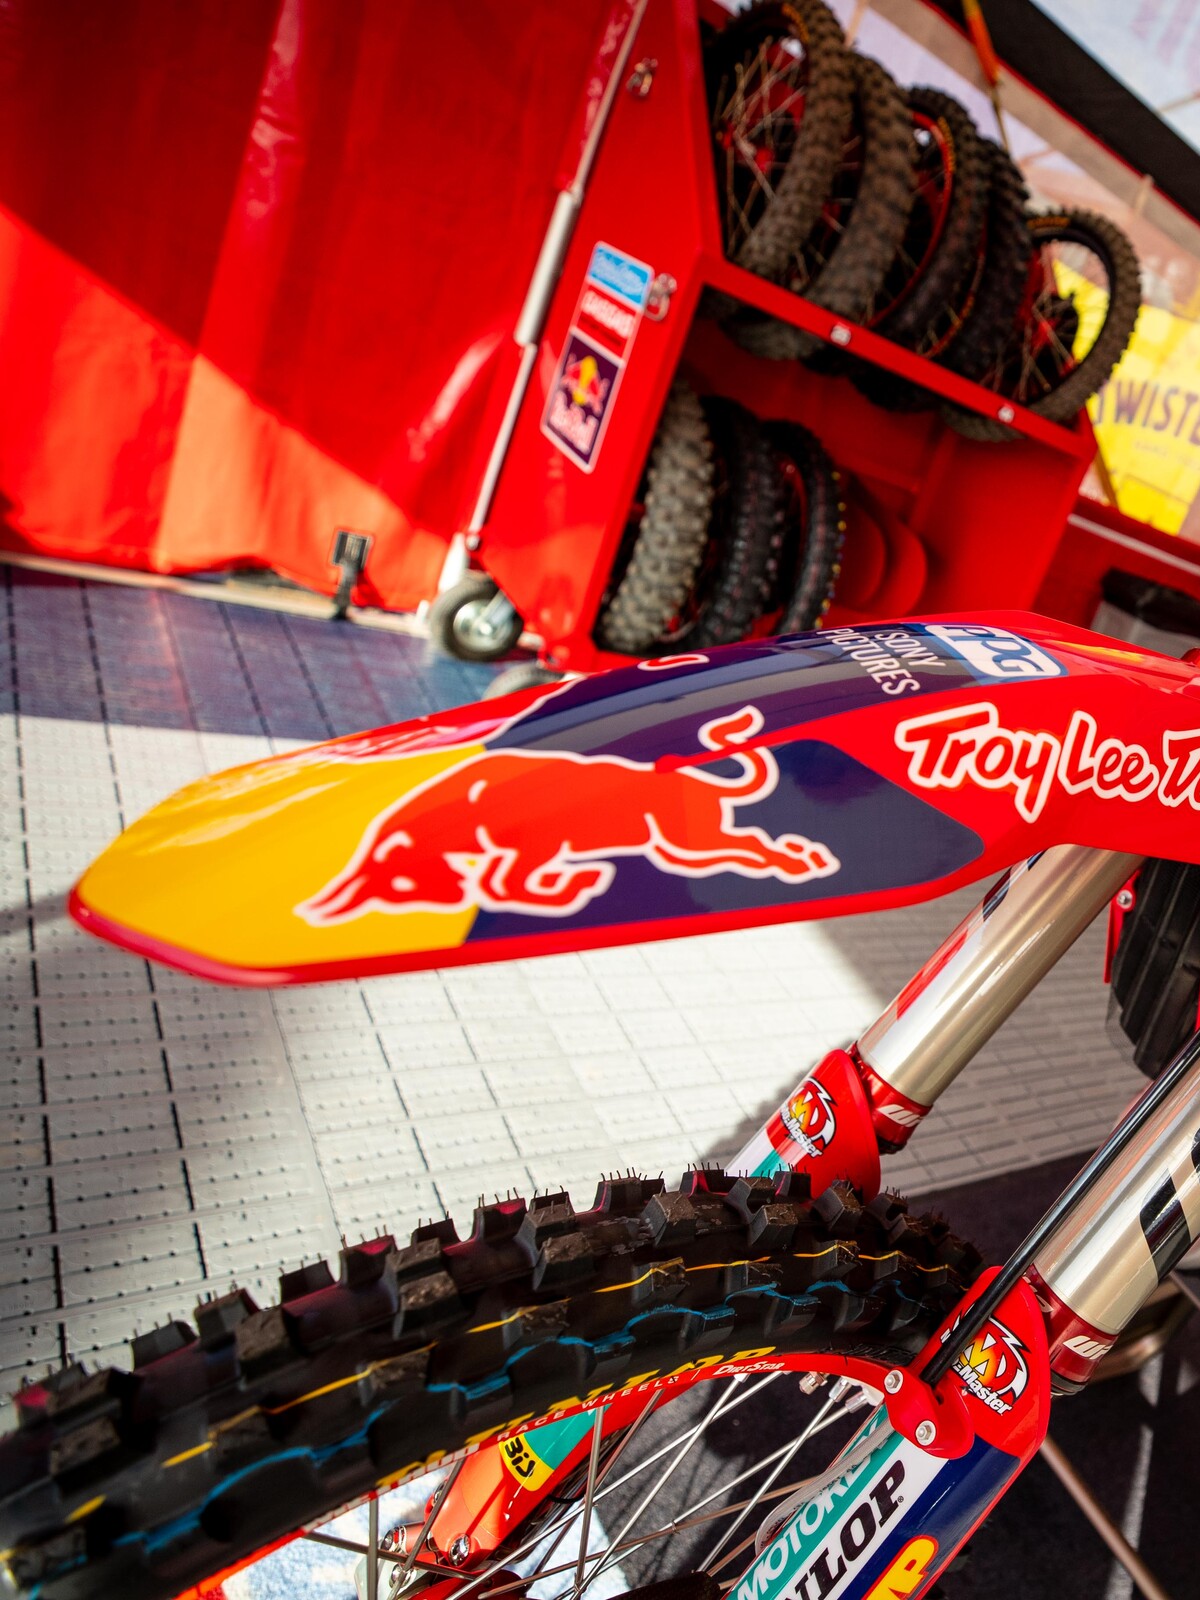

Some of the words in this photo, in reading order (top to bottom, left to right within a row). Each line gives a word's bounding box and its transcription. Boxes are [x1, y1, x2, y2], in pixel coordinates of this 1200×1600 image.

[816, 627, 921, 696] PICTURES
[875, 631, 946, 668] SONY
[894, 701, 1061, 824] Troy
[1057, 710, 1160, 802] Lee
[497, 1408, 567, 1442] RACE
[581, 1376, 680, 1410] WHEELS
